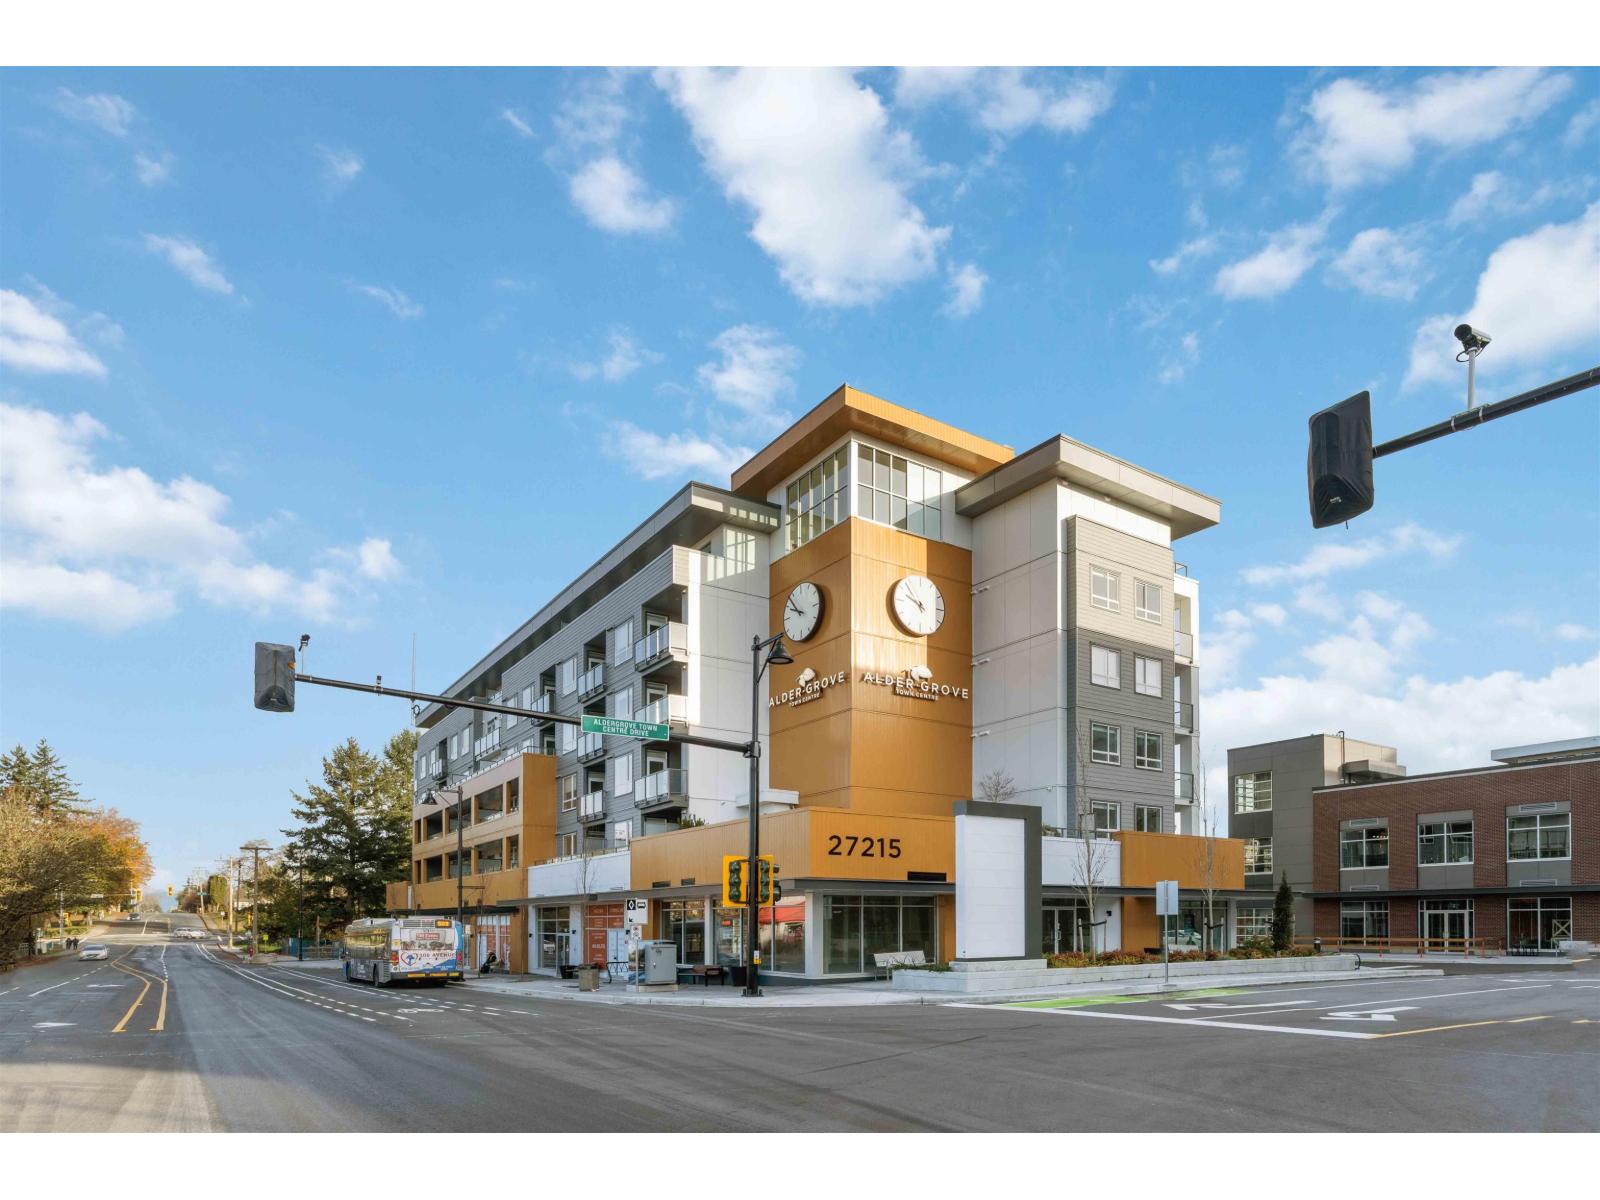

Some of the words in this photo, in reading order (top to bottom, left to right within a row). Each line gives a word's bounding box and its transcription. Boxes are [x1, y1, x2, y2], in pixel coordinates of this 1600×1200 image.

[789, 699, 802, 707] TOWN
[802, 692, 820, 703] CENTRE
[895, 688, 915, 696] TOWN
[915, 692, 939, 701] CENTRE
[593, 718, 637, 729] ALDERGROVE
[602, 726, 628, 734] CENTRE
[828, 834, 901, 858] 27215
